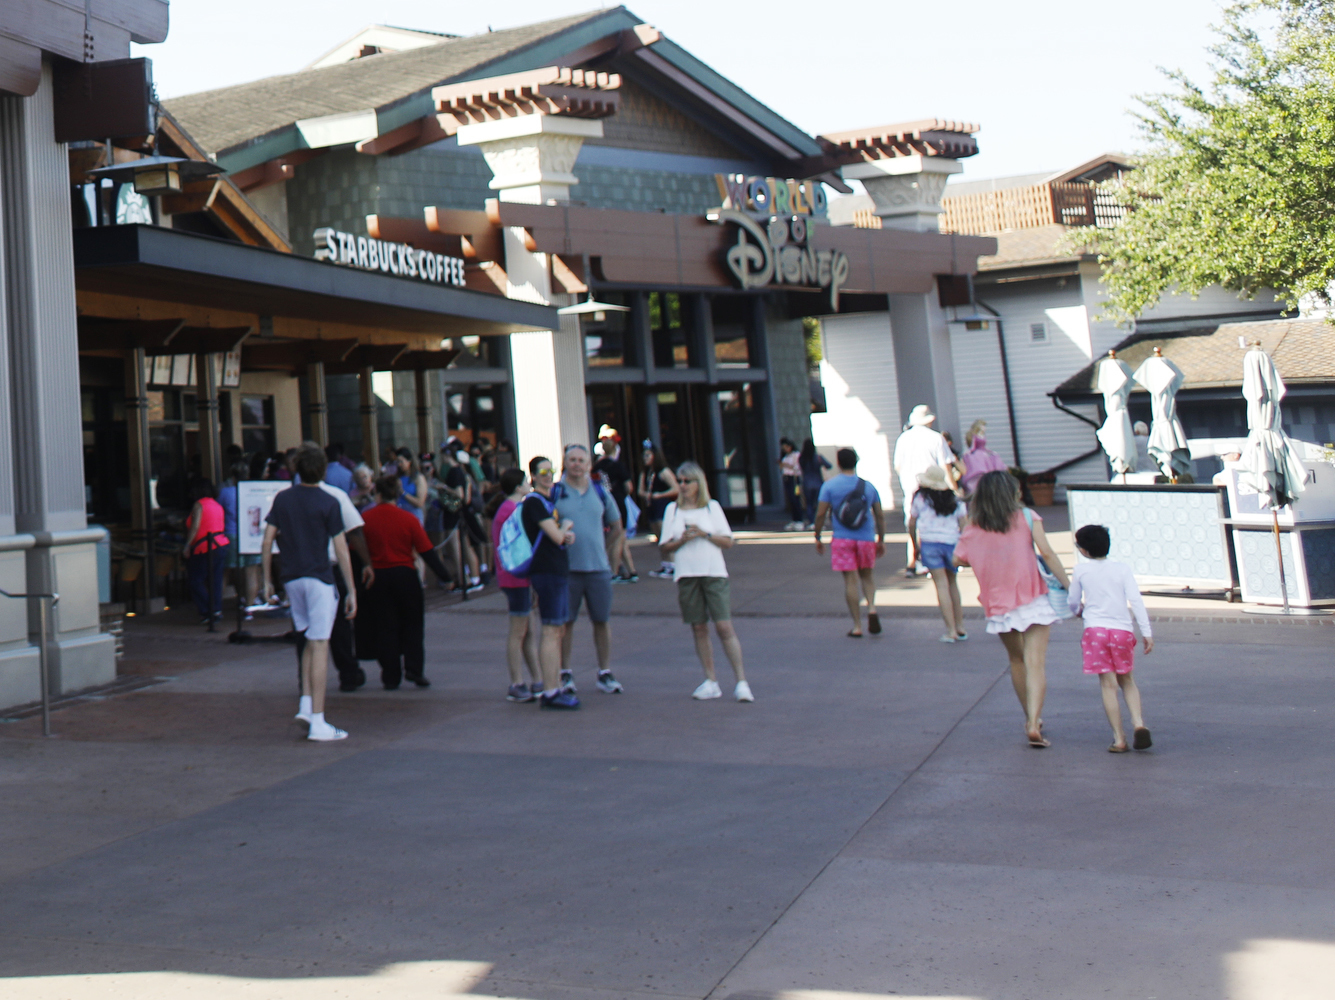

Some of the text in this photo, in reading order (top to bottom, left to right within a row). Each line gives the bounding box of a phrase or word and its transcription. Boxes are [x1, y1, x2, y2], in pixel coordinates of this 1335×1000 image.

[720, 174, 828, 216] WORLD
[324, 227, 467, 287] STARBUCKS COFFEE
